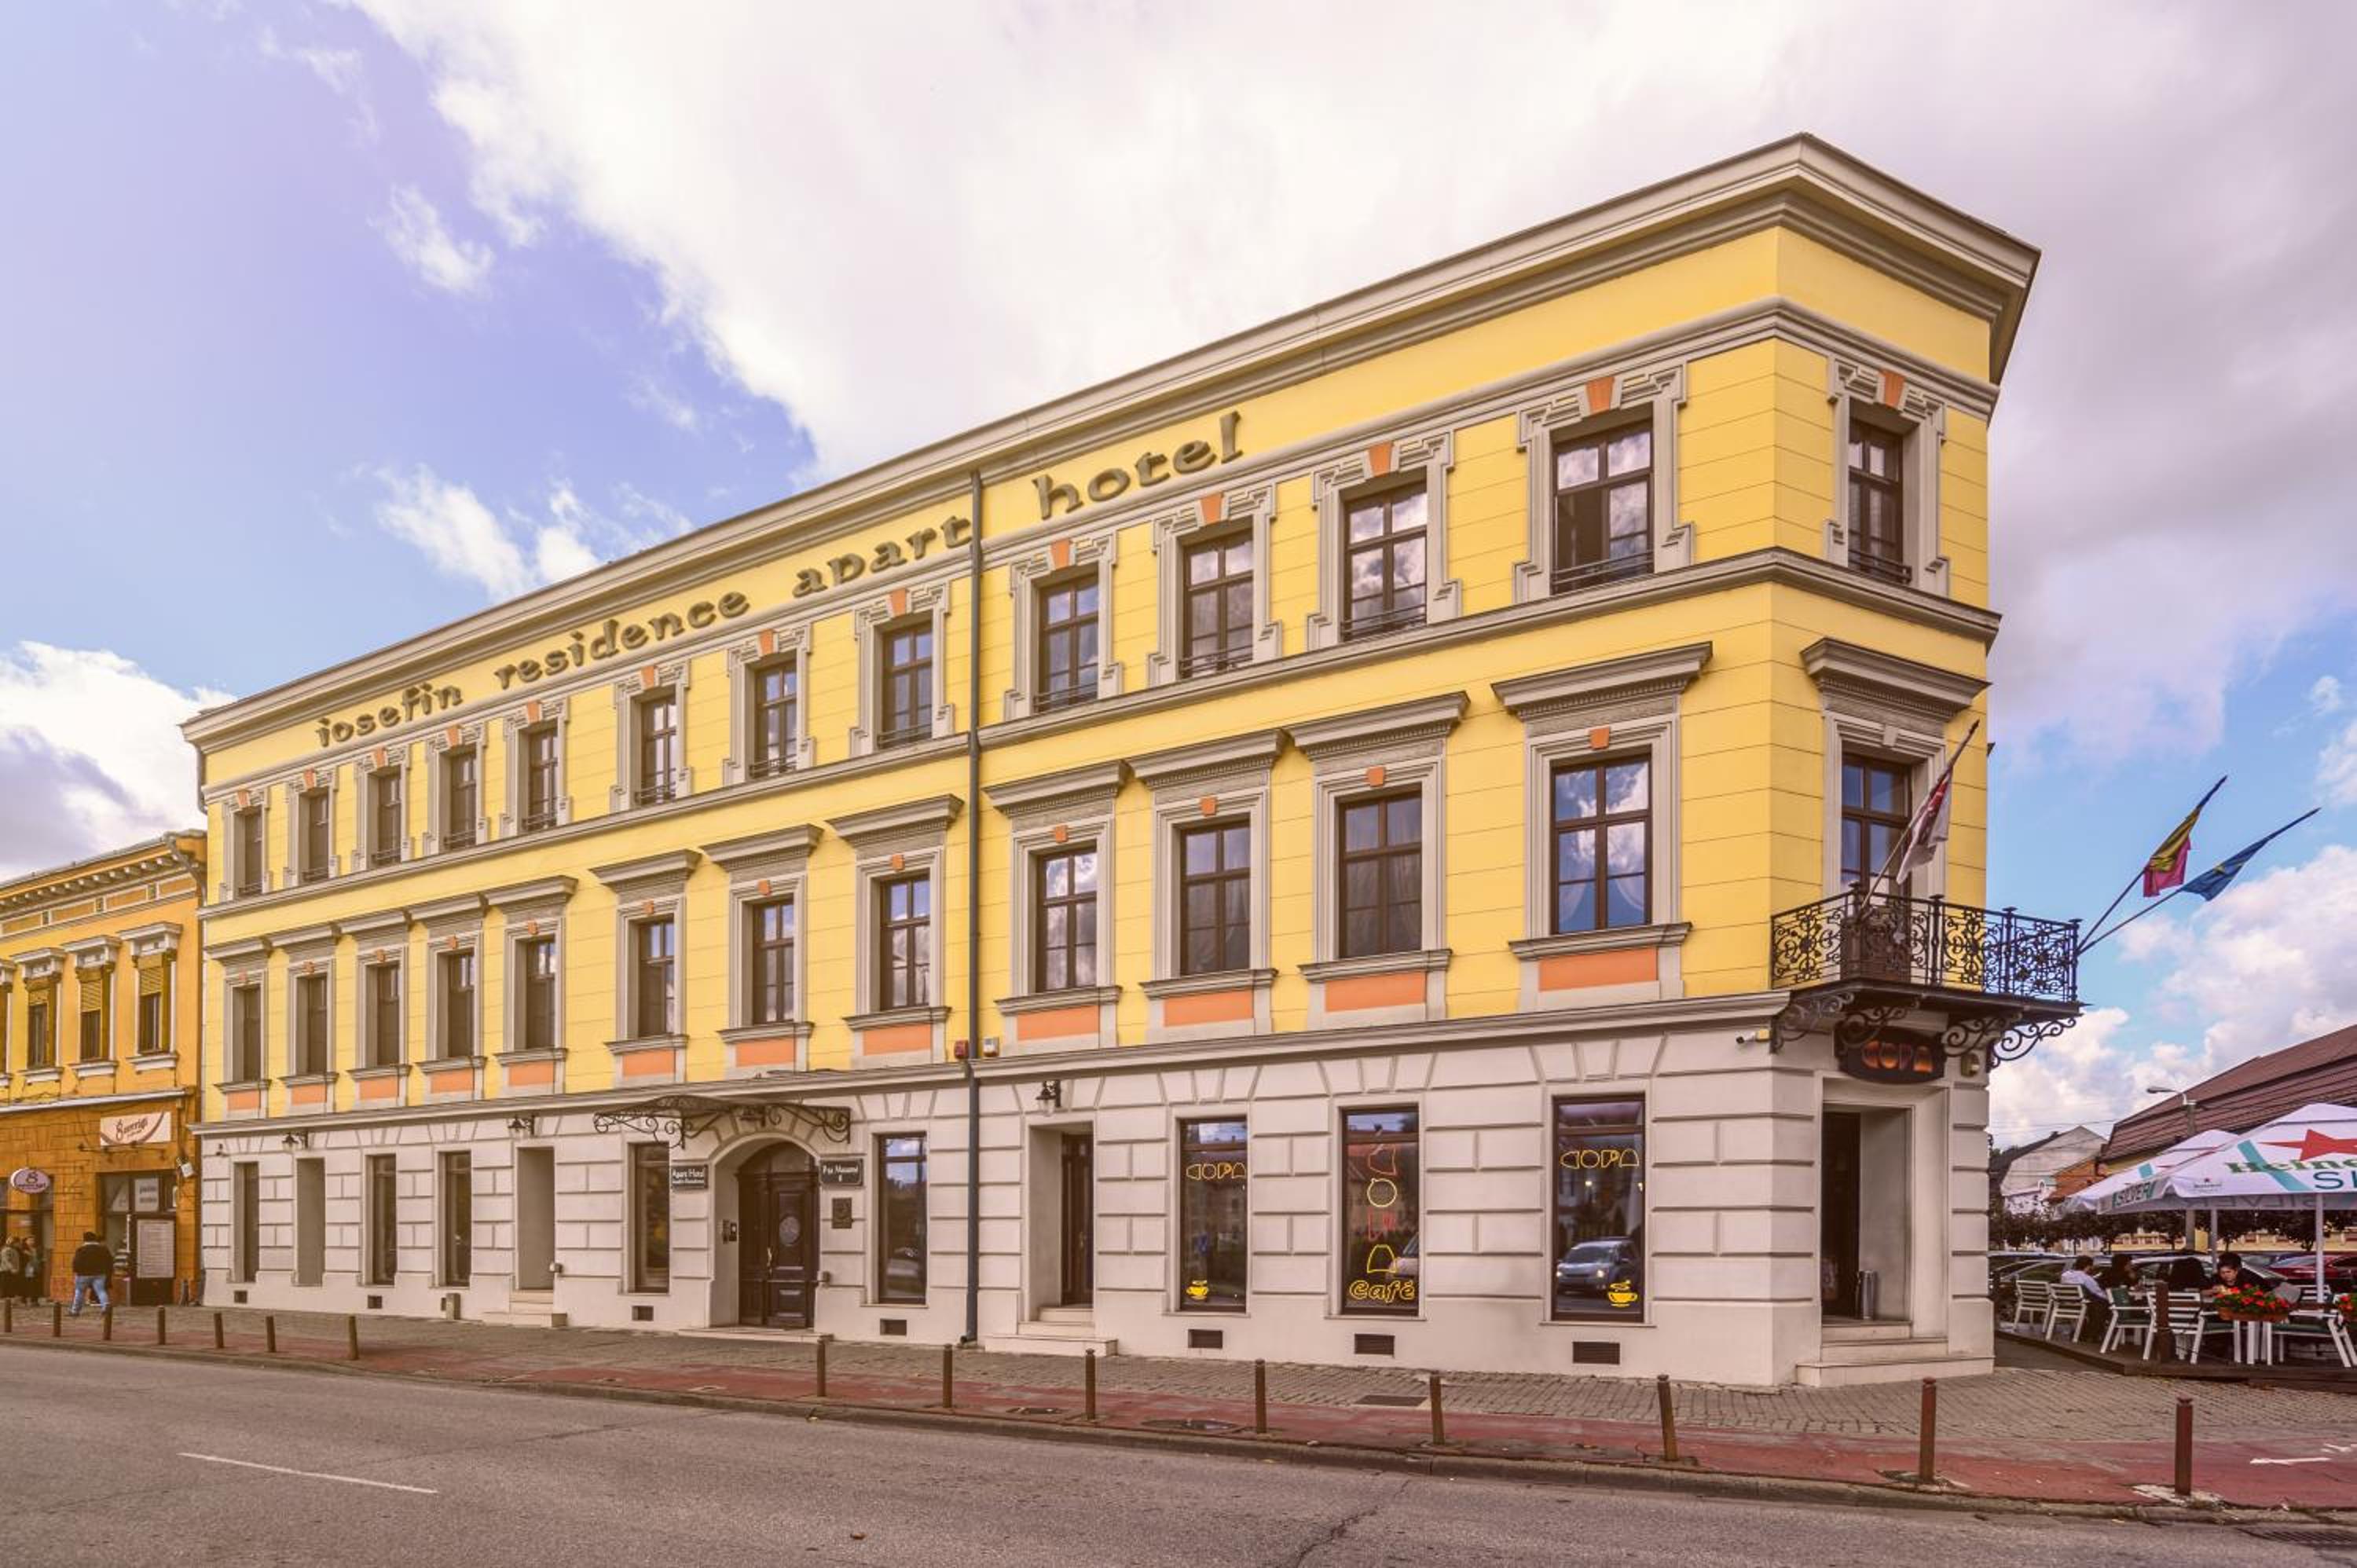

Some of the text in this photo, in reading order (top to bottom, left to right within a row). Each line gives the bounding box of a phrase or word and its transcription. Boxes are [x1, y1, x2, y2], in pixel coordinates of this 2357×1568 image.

[314, 411, 1243, 747] iosefin residence apart hotel
[1560, 1149, 1640, 1169] COPA
[1186, 1162, 1246, 1181] COPA
[1349, 1280, 1415, 1303] Café
